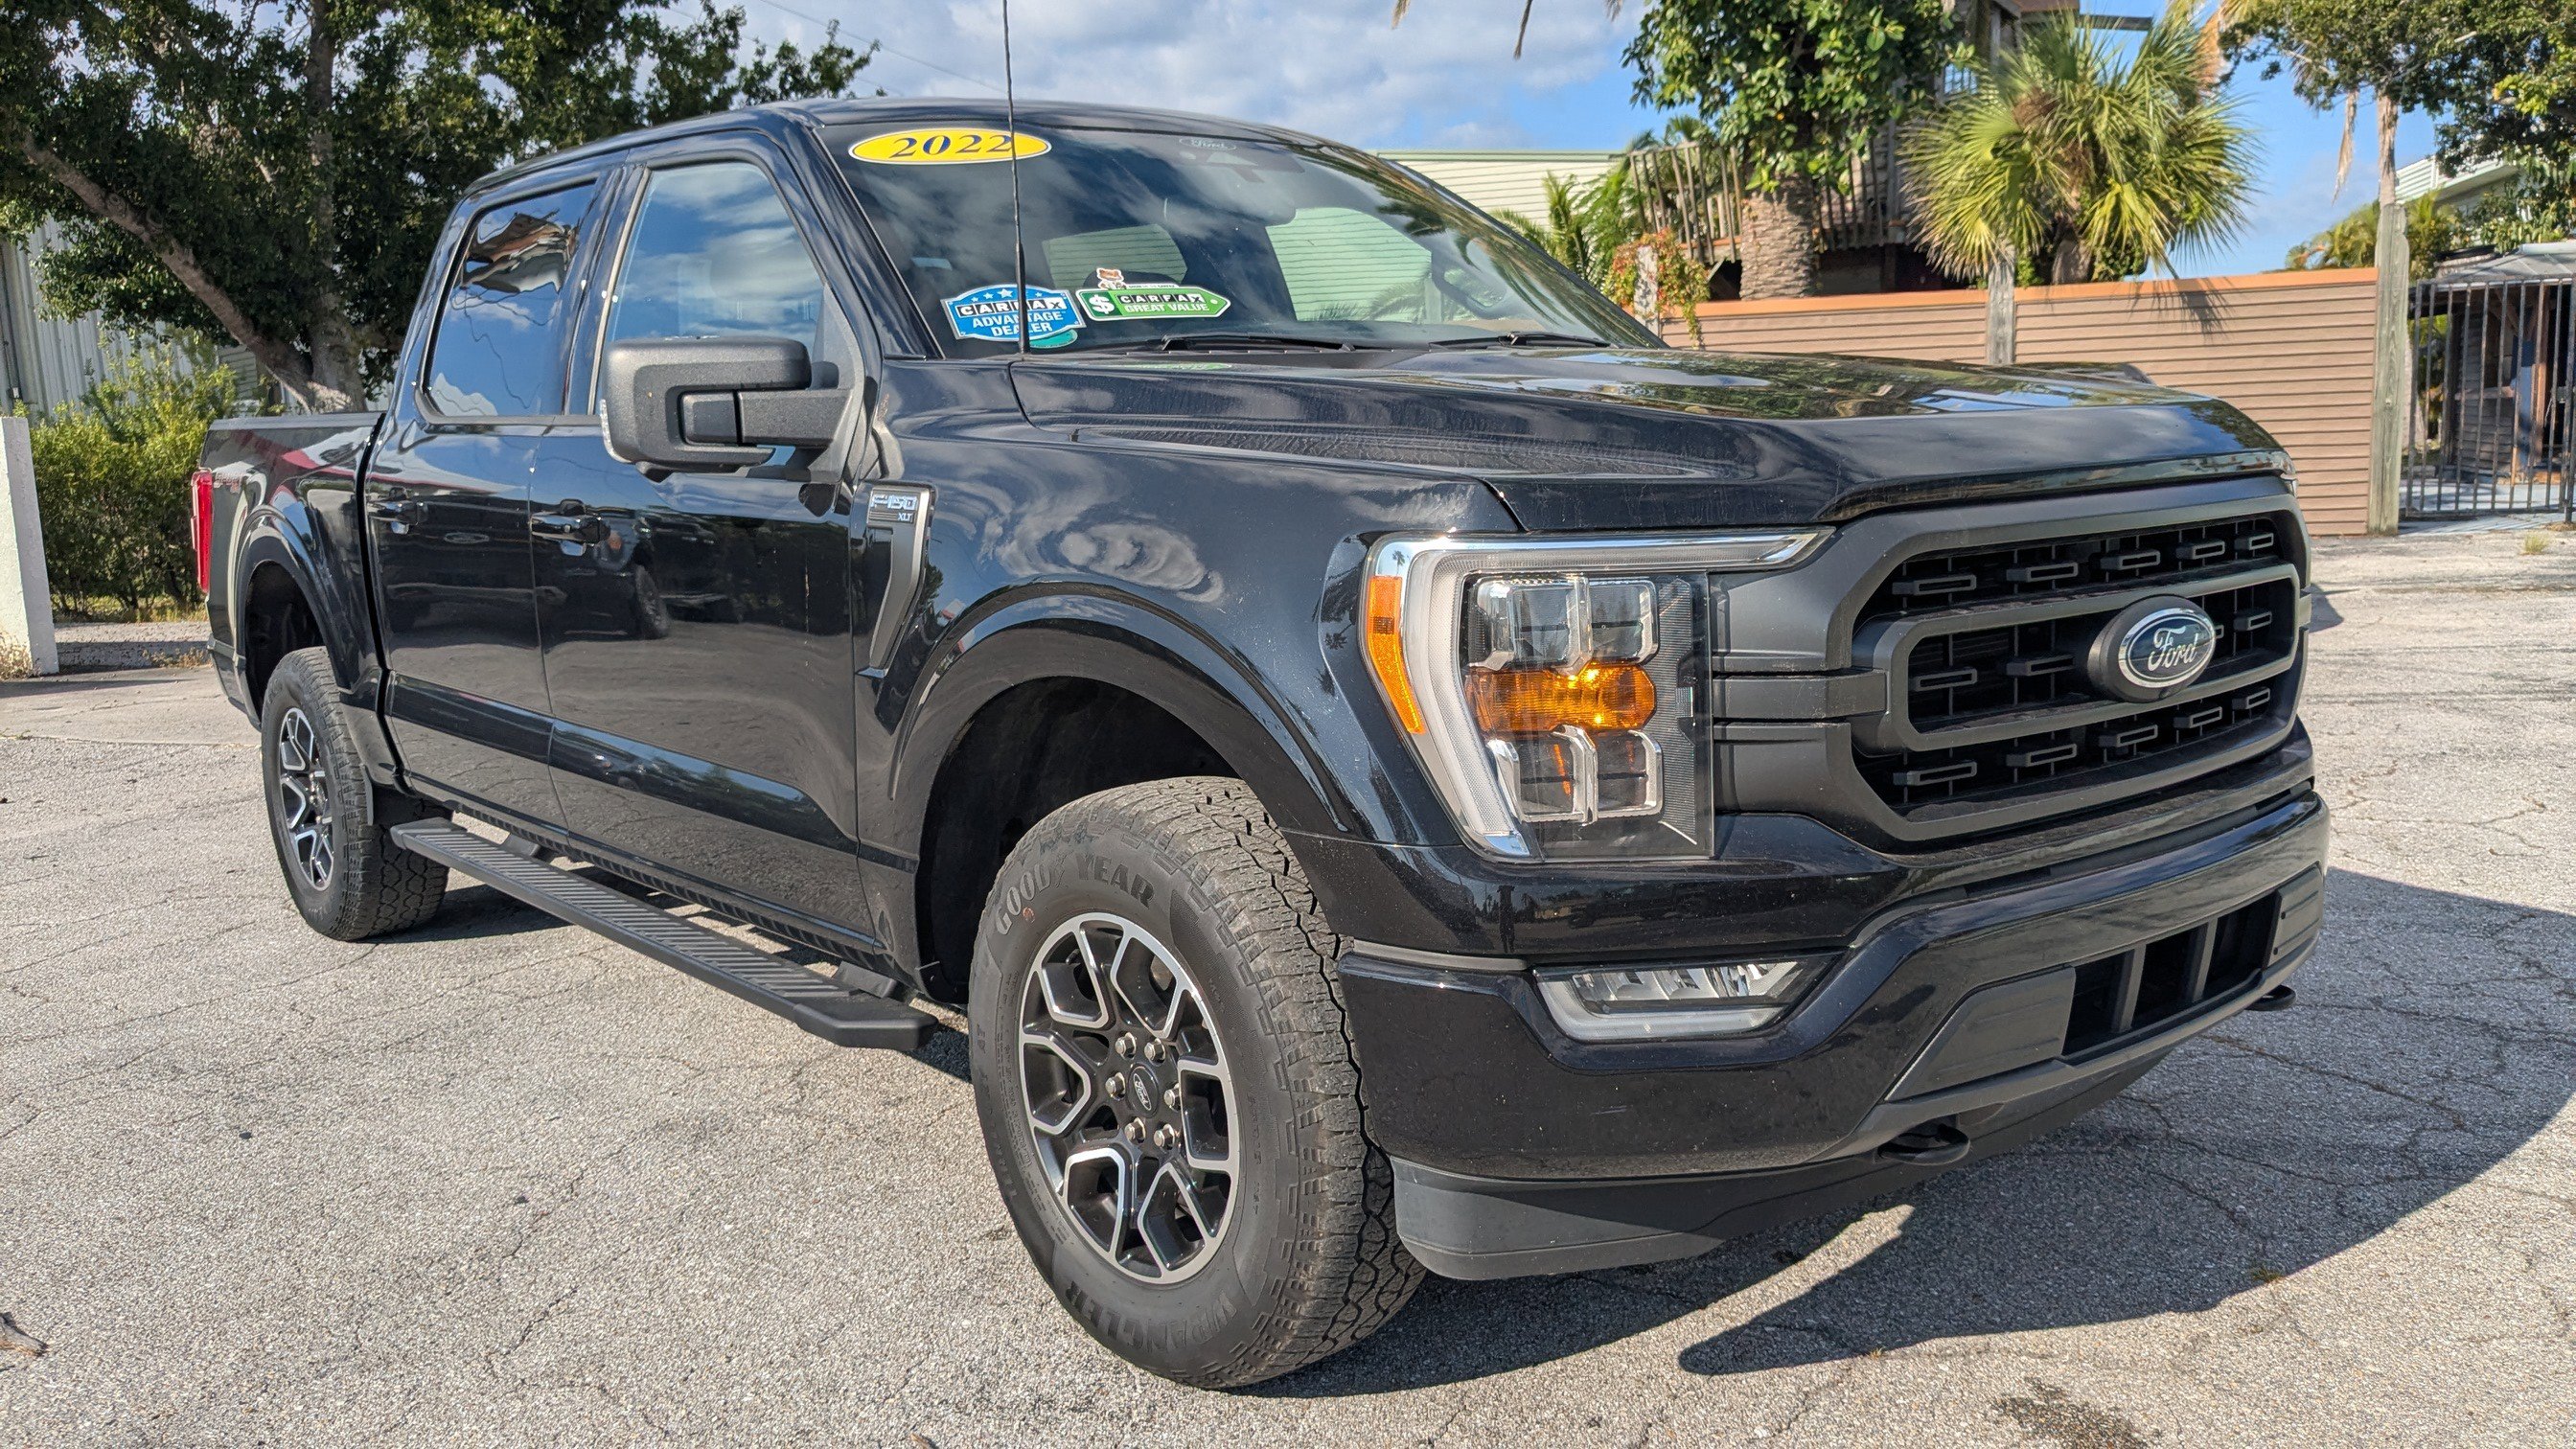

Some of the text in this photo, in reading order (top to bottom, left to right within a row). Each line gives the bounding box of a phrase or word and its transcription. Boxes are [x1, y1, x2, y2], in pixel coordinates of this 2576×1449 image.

[888, 134, 1013, 159] 2022
[1117, 293, 1207, 305] CARFAX
[1123, 303, 1210, 313] GREAT VALUE
[990, 322, 1053, 337] DEAER
[898, 513, 912, 522] XLT
[2148, 625, 2199, 672] Ford
